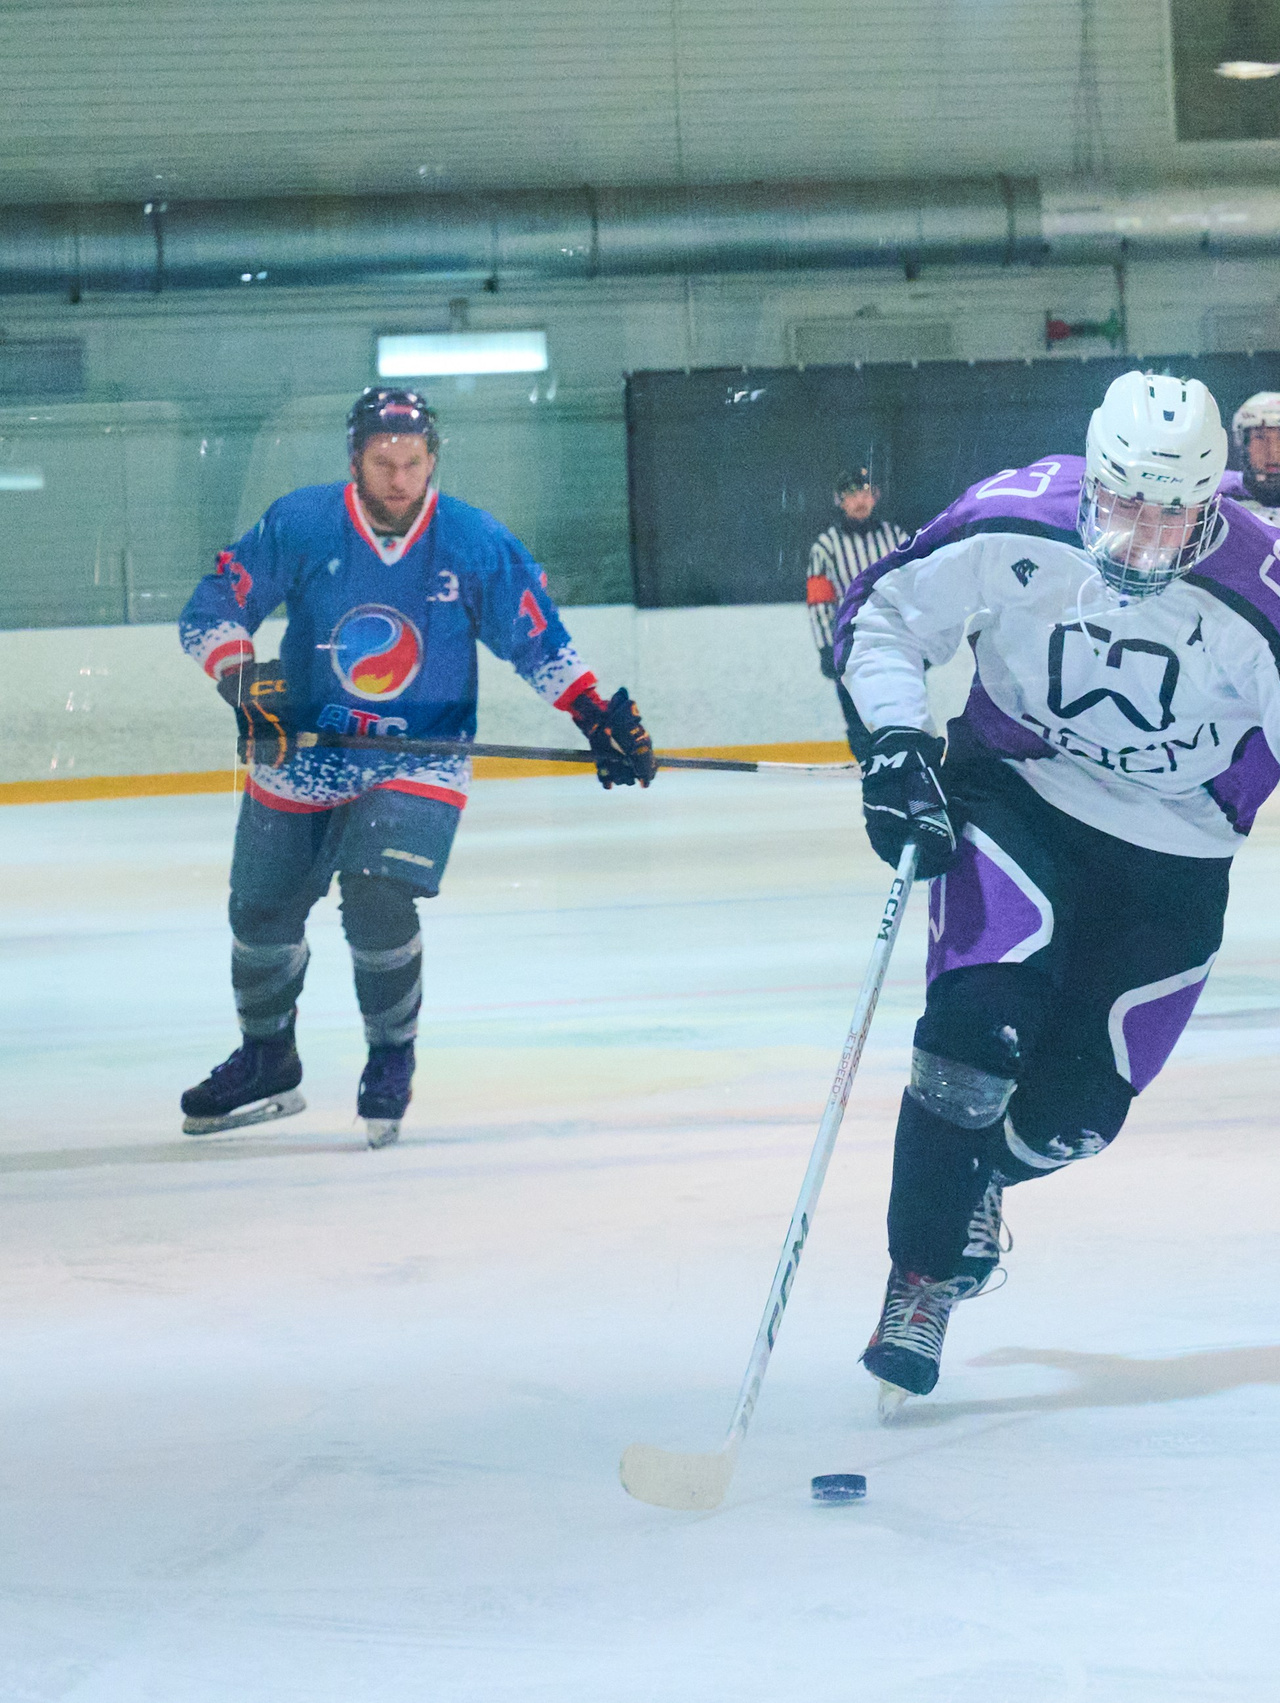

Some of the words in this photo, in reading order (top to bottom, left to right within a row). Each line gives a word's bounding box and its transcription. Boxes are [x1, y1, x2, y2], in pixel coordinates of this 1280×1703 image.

[1141, 472, 1184, 484] CCM
[877, 878, 905, 941] CCM
[832, 1027, 858, 1095] JETSPEED
